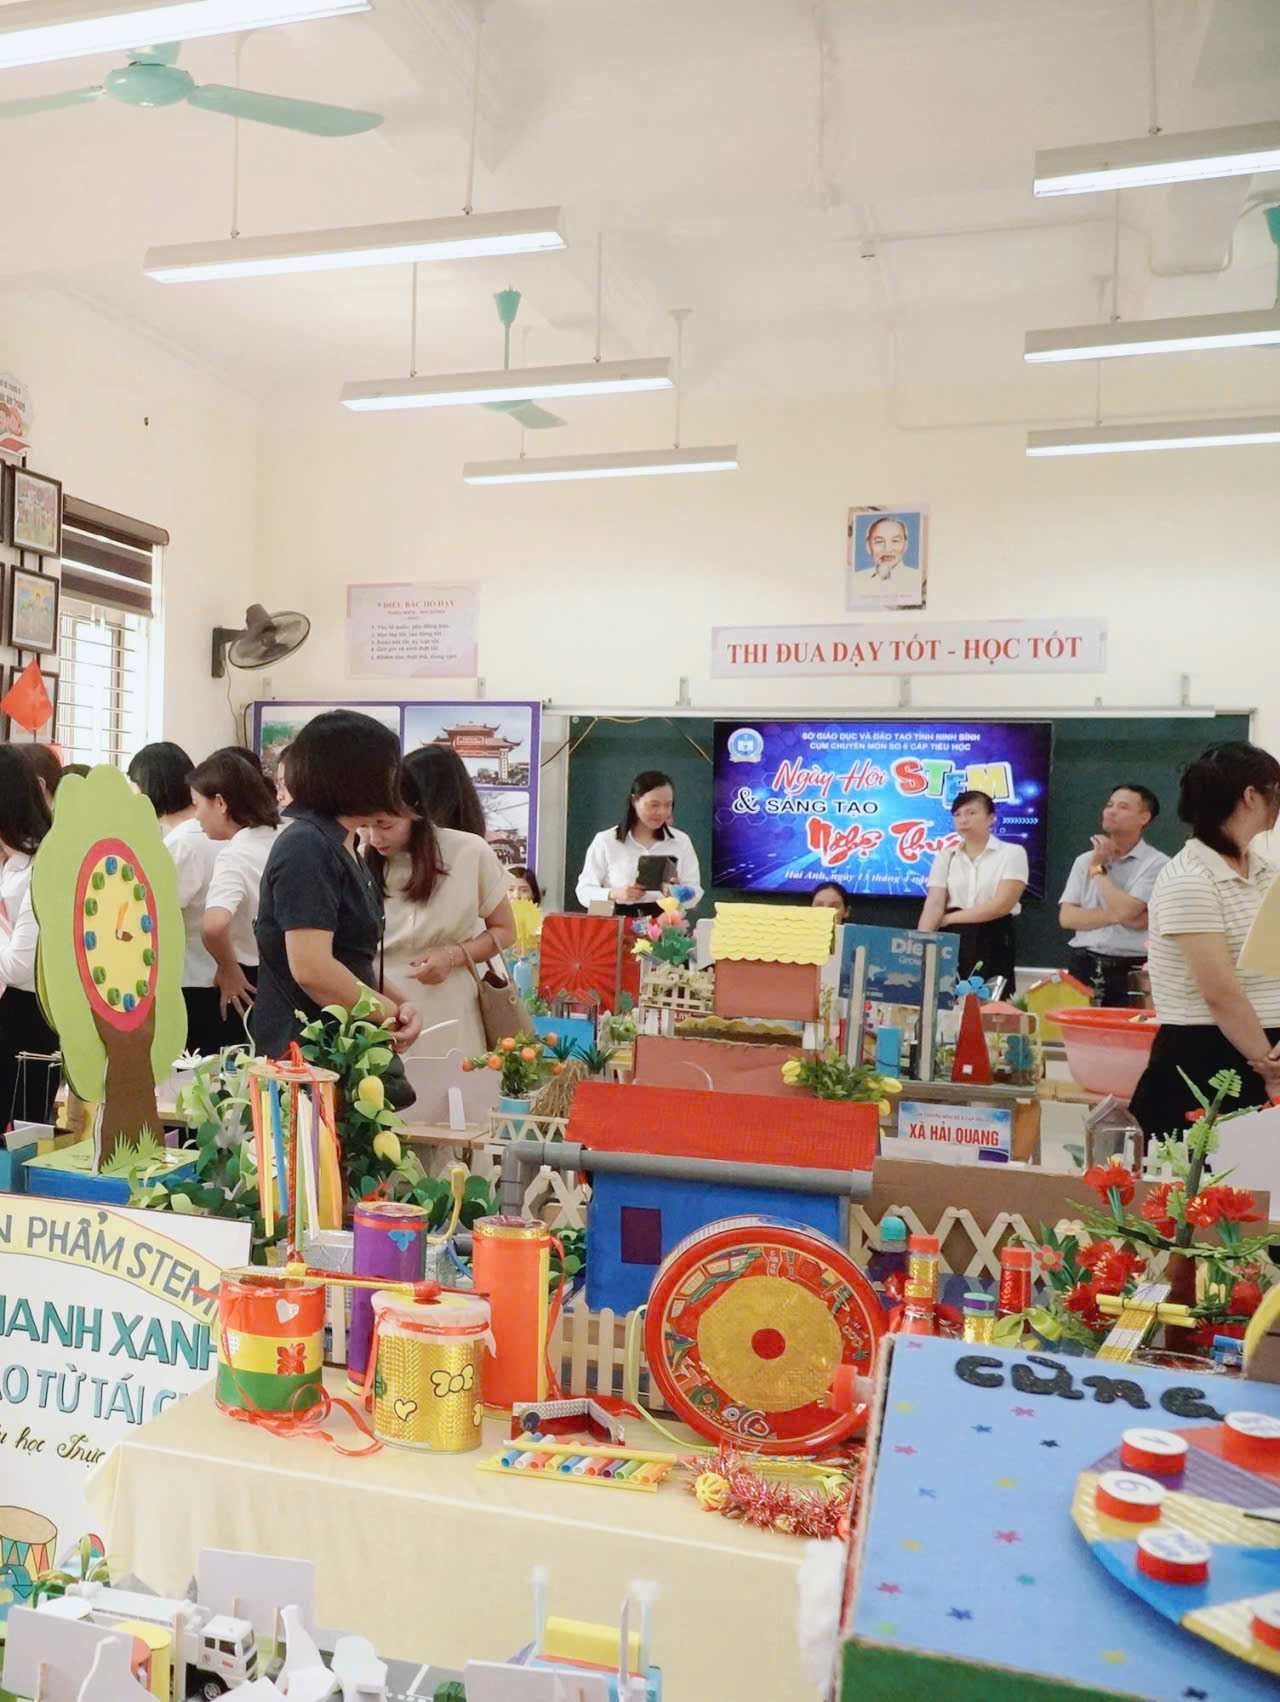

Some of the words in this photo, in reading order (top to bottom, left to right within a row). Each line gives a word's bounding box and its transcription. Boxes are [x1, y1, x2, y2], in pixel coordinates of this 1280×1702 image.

[727, 642, 769, 665] THI
[776, 641, 826, 665] ĐUA
[832, 639, 884, 668] DẠY
[890, 633, 942, 662] TỐT
[963, 637, 1021, 666] HỌC
[1027, 631, 1083, 660] TỐT
[732, 787, 760, 814] &
[767, 796, 827, 813] SÁNG
[834, 801, 879, 816] TẠO
[772, 757, 834, 797] Ngày
[837, 758, 887, 794] Hội
[892, 757, 1016, 806] STEM
[909, 1121, 926, 1140] XÃ
[930, 1120, 951, 1142] HẢI
[956, 1127, 999, 1146] QUANG
[27, 1210, 125, 1271] PHẨM
[126, 1242, 221, 1317] STEM
[108, 1311, 218, 1371] XANH
[36, 1362, 87, 1414] TỪ
[90, 1371, 145, 1426] TÁI
[14, 1426, 47, 1458] học
